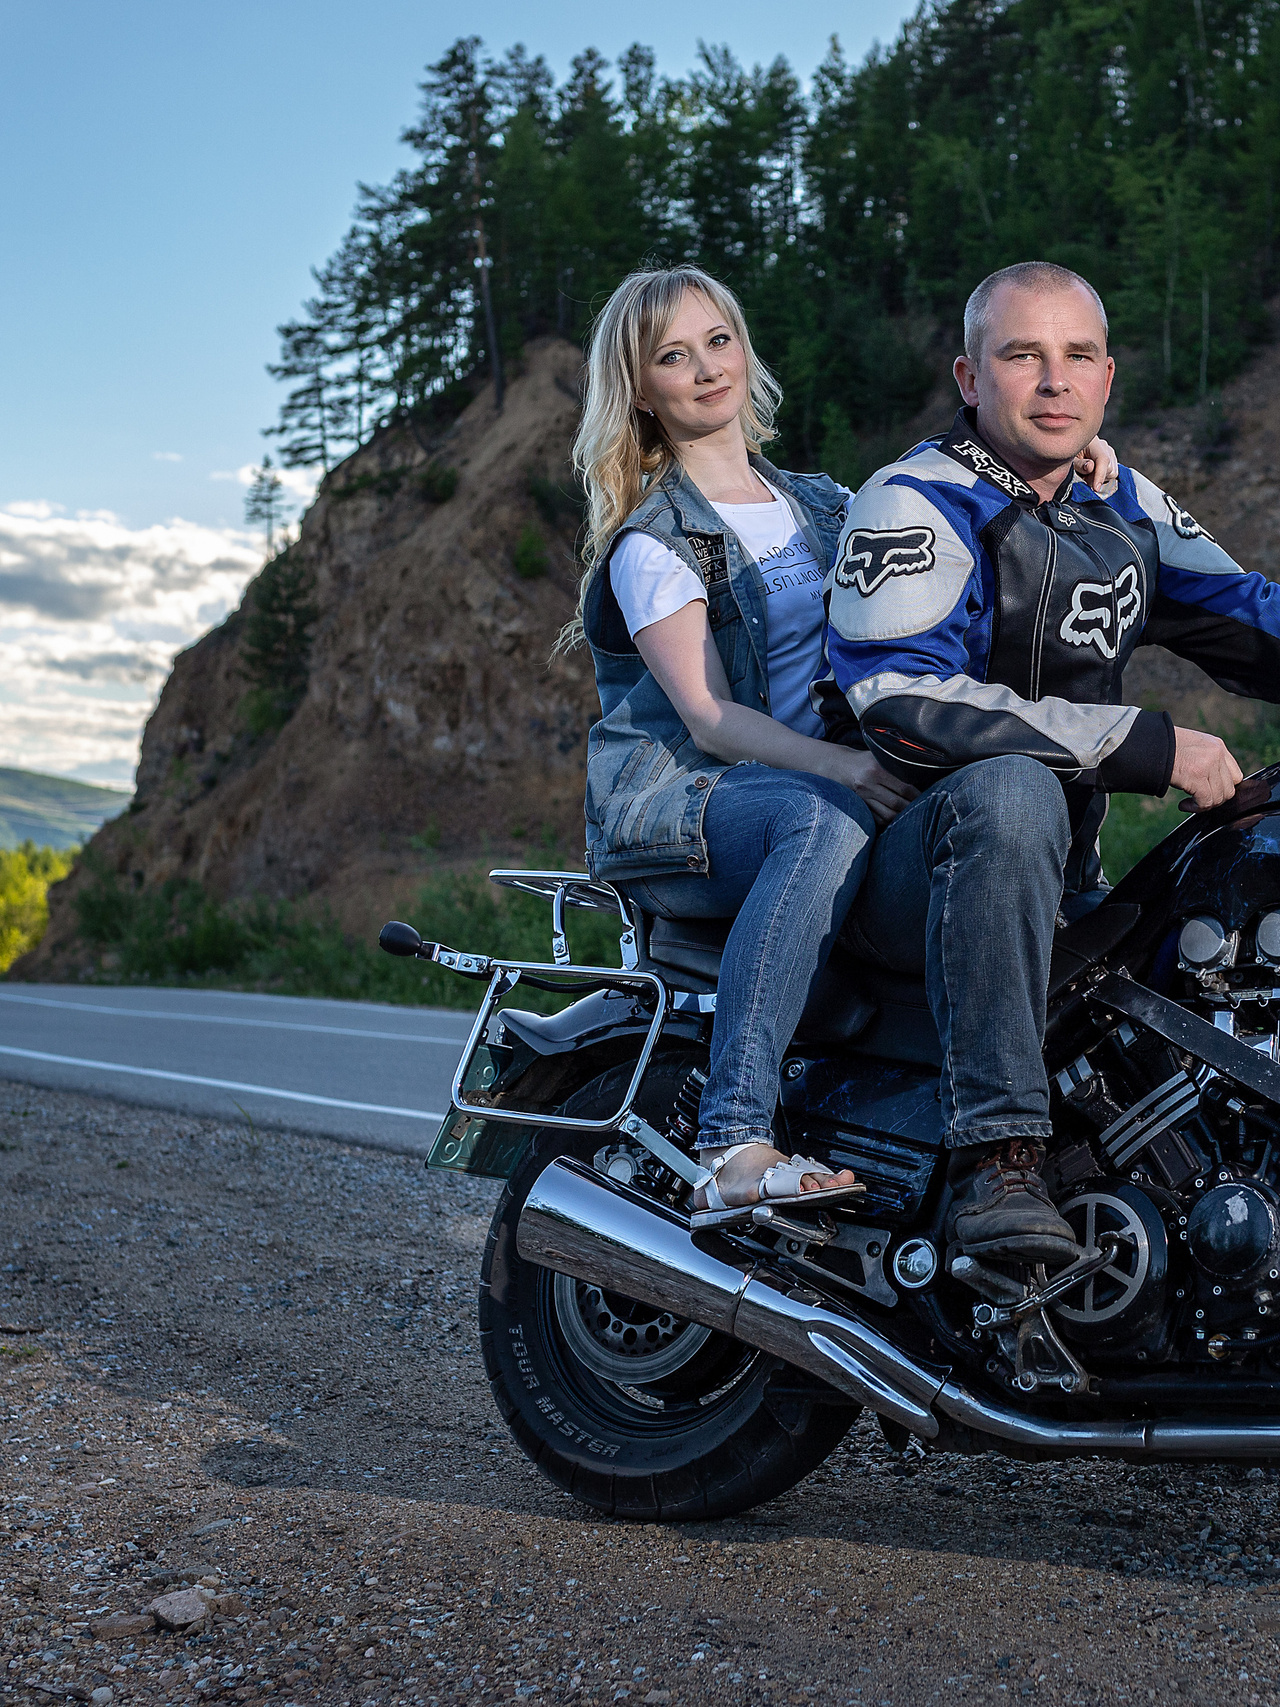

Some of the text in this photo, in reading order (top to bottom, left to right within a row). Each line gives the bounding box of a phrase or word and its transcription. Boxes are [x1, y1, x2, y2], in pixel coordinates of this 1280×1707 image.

[951, 439, 1032, 497] FOX
[508, 1323, 621, 1458] TOUR MASTER
